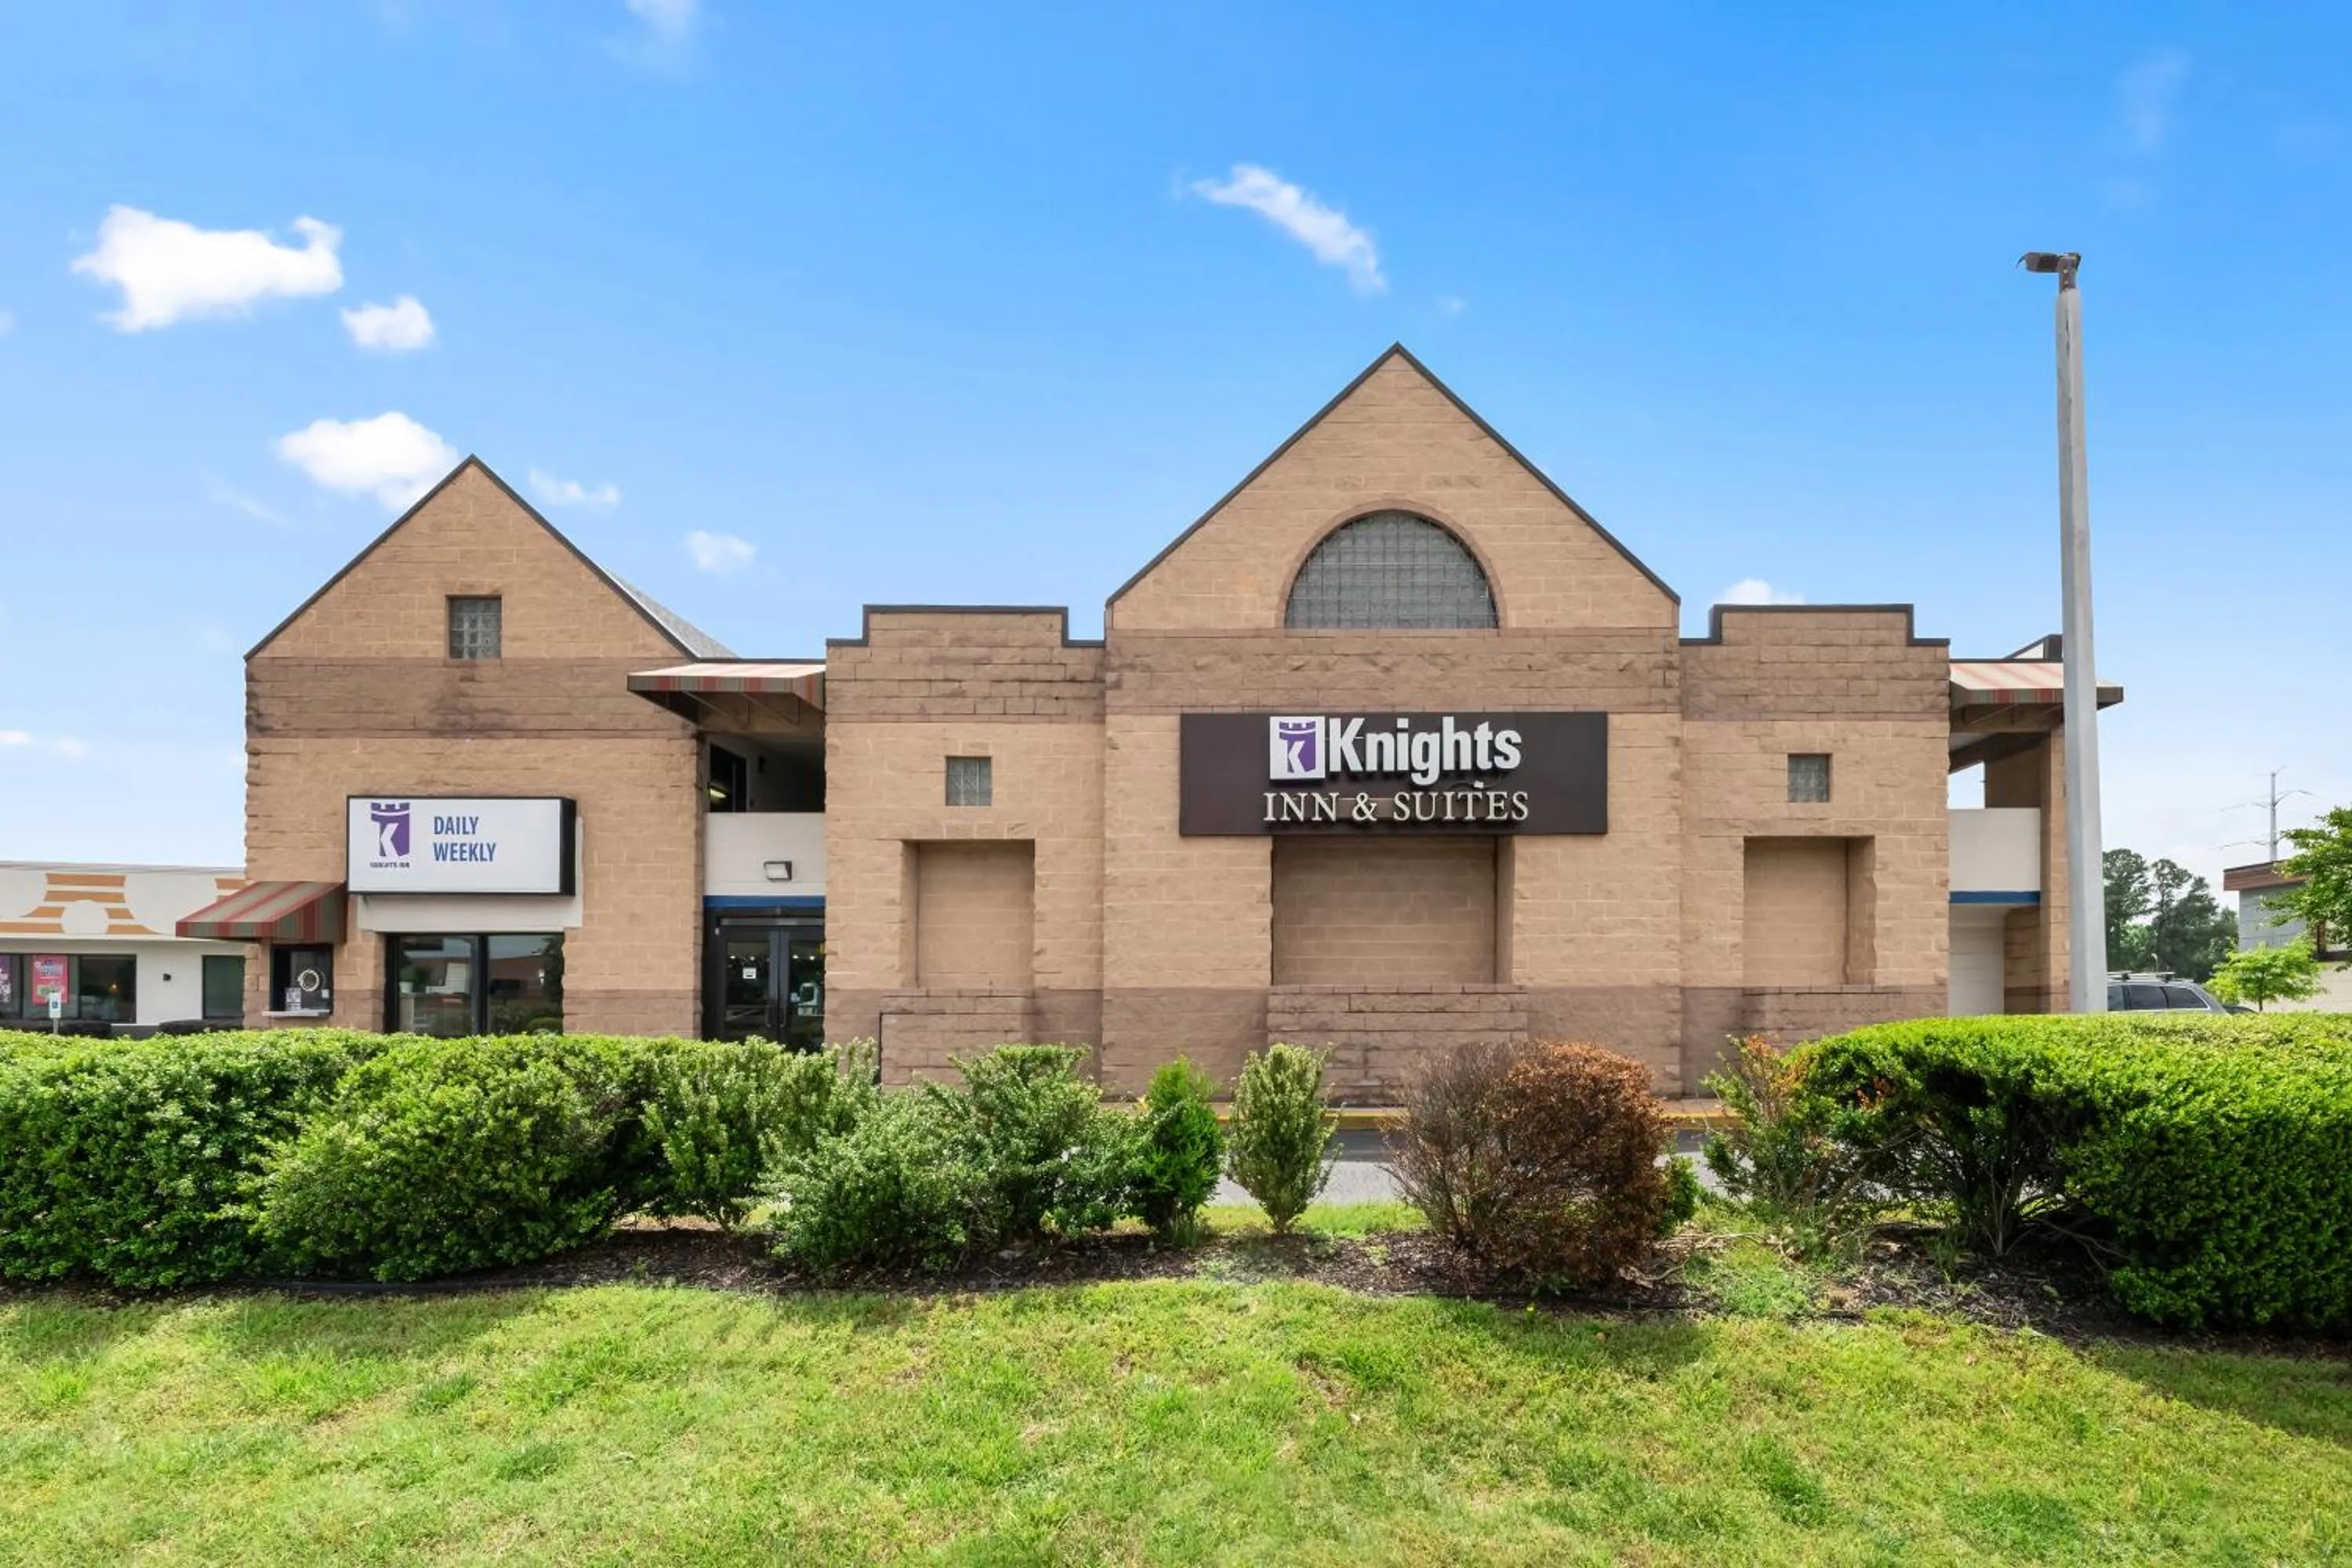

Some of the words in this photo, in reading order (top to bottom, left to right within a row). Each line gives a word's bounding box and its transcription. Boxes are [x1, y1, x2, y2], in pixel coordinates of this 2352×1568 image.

[1328, 717, 1523, 785] Knights
[1263, 792, 1340, 822] INN
[1351, 792, 1377, 822] &
[1392, 790, 1529, 822] SUITES
[434, 816, 479, 835] DAILY
[433, 842, 495, 862] WEEKLY
